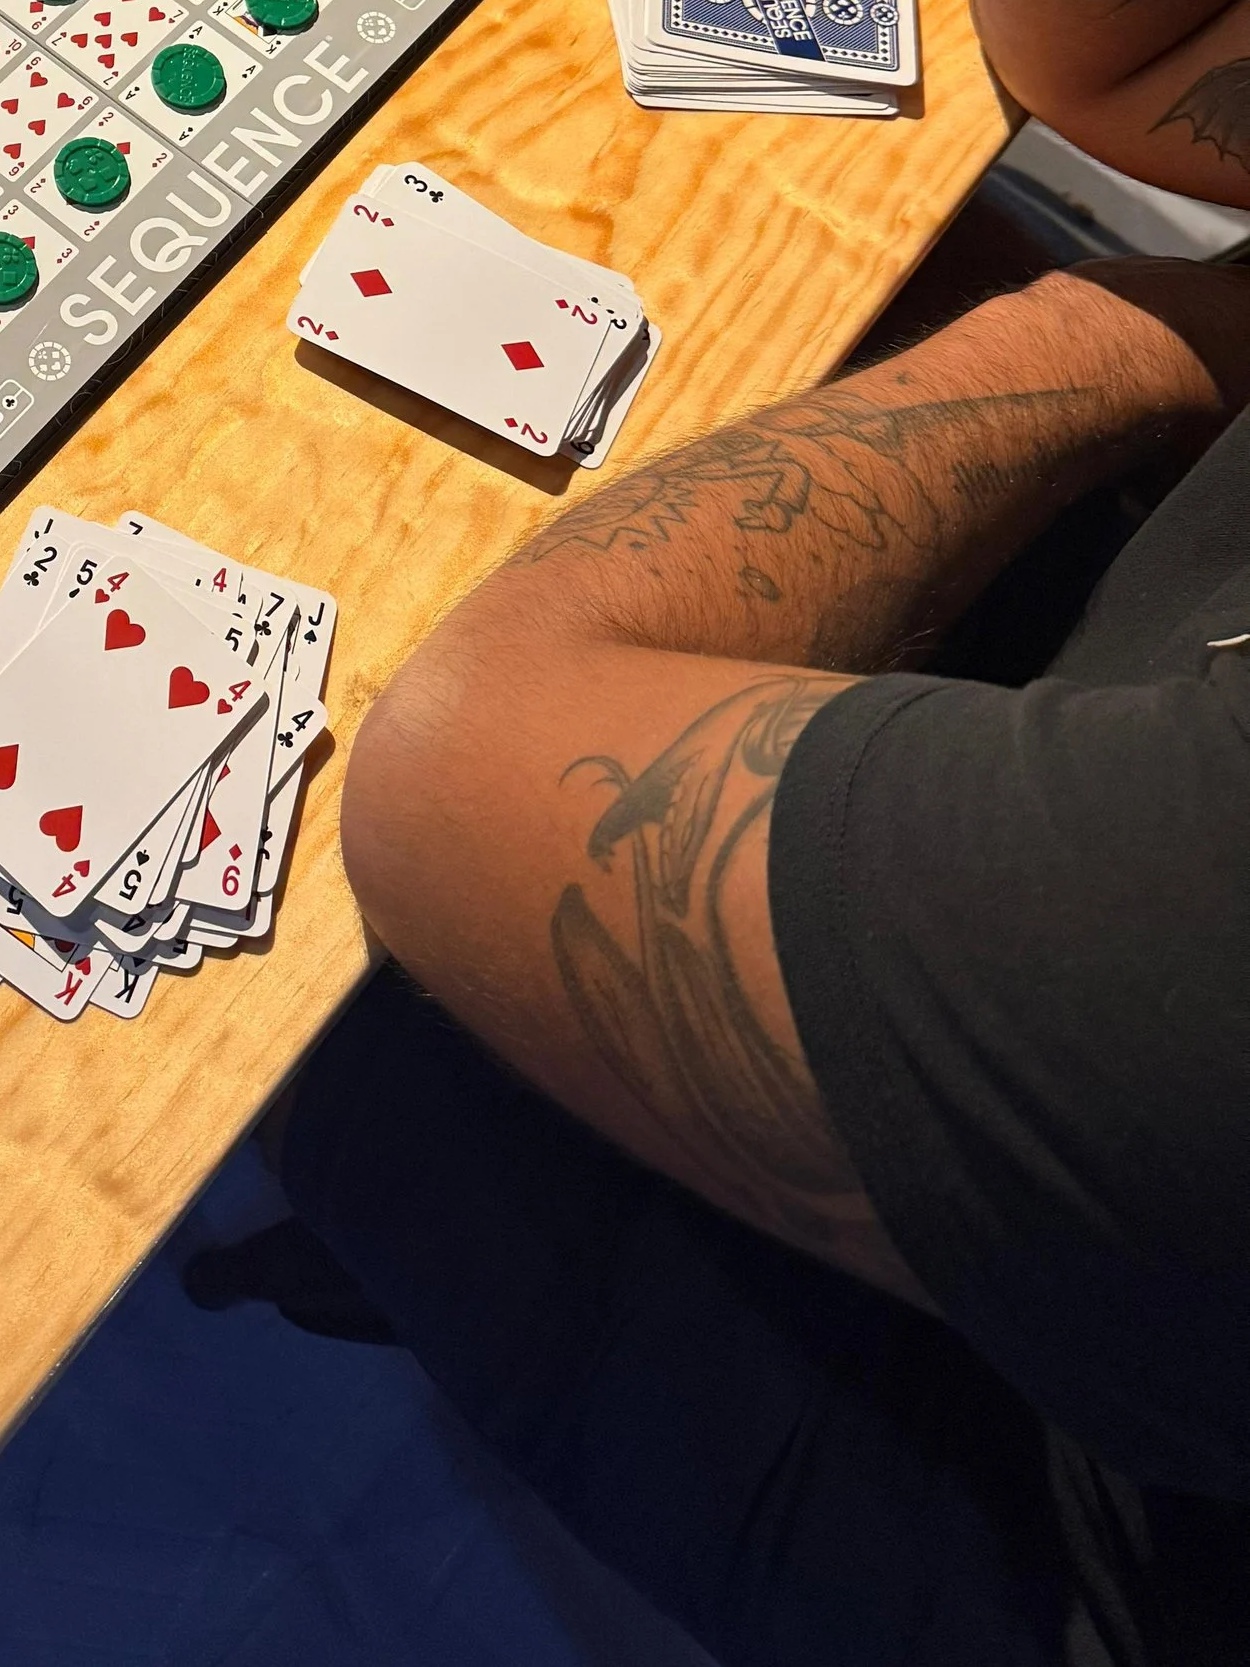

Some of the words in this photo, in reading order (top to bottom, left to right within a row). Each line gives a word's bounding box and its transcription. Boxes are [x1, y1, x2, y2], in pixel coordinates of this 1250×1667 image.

[173, 9, 184, 18] 7
[212, 6, 224, 16] K
[192, 26, 203, 36] A
[51, 37, 62, 46] 7
[266, 44, 277, 54] K
[30, 57, 41, 66] 6
[245, 65, 256, 75] A
[103, 76, 114, 86] 7
[82, 96, 93, 106] 6
[125, 90, 136, 100] A
[179, 131, 190, 141] A
[8, 166, 20, 176] 6
[404, 175, 428, 192] 3
[59, 40, 370, 347] SEQUENCE
[8, 205, 19, 215] 3
[354, 205, 379, 223] 2
[61, 248, 73, 258] 3
[571, 305, 598, 325] 2
[297, 316, 324, 335] 2
[521, 423, 548, 444] 2
[34, 546, 57, 572] 2
[77, 559, 97, 585] 5
[213, 568, 227, 593] 4
[107, 572, 130, 592] 4
[265, 592, 285, 617] 7
[308, 602, 325, 626] J
[225, 627, 243, 652] 5
[228, 680, 252, 702] 4
[291, 710, 314, 732] 4
[52, 873, 77, 898] 4
[119, 869, 142, 901] 5
[54, 971, 83, 1006] K
[114, 974, 141, 1004] K
